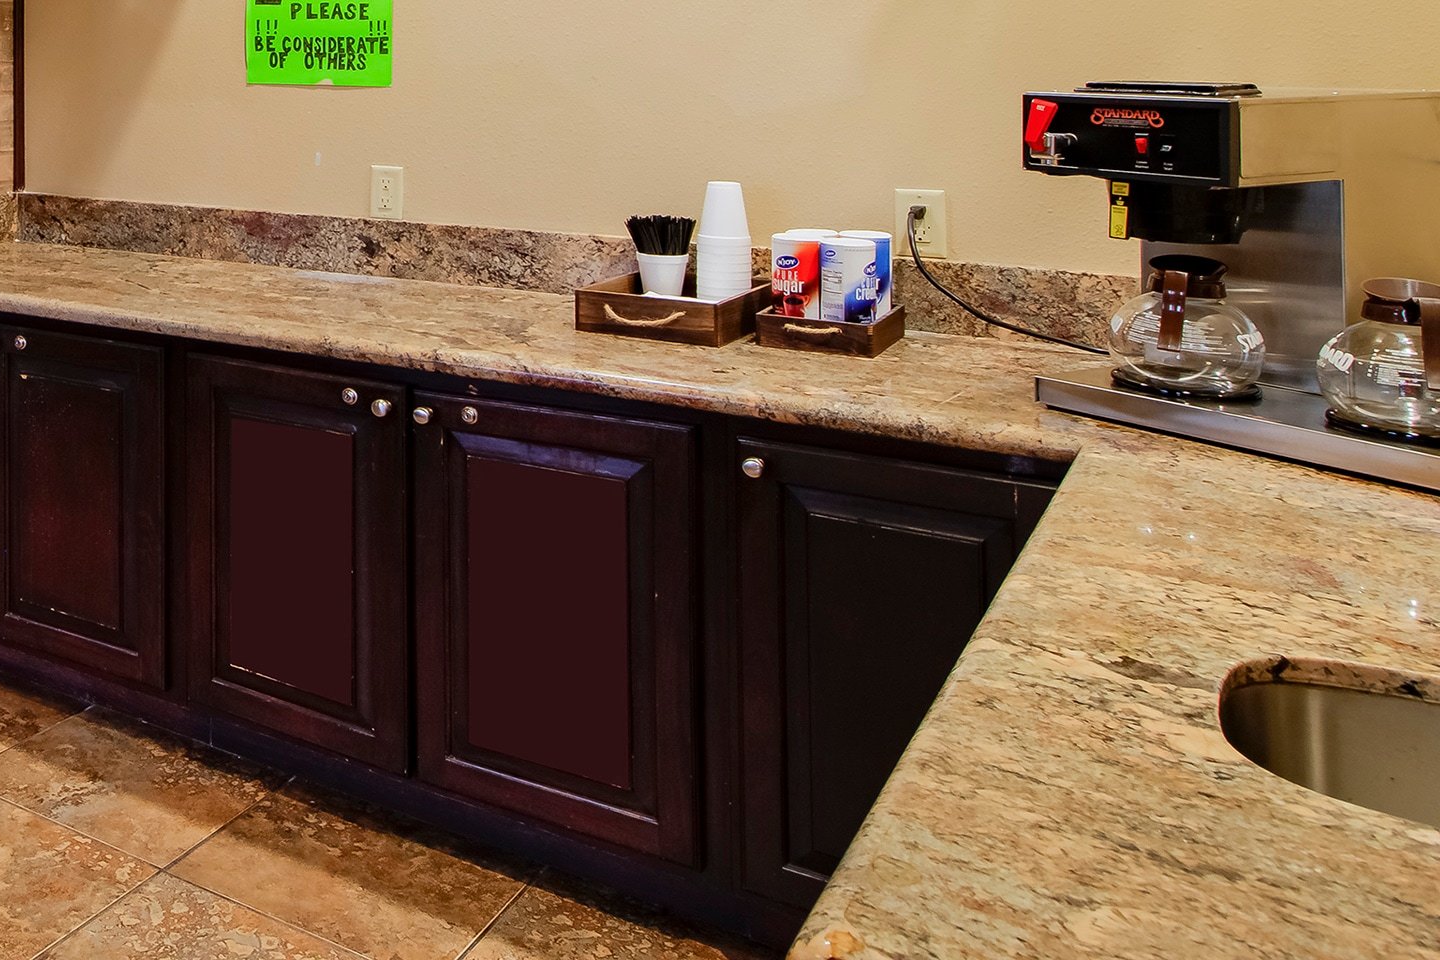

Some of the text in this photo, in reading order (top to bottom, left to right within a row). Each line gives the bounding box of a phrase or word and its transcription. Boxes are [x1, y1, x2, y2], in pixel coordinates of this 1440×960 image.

[290, 2, 369, 20] PLEASE
[254, 36, 389, 54] BE CONSIDERATE
[269, 51, 367, 70] OF OTHERS
[1090, 108, 1164, 128] STANDARD
[776, 269, 799, 281] PURE
[772, 279, 805, 296] sugar
